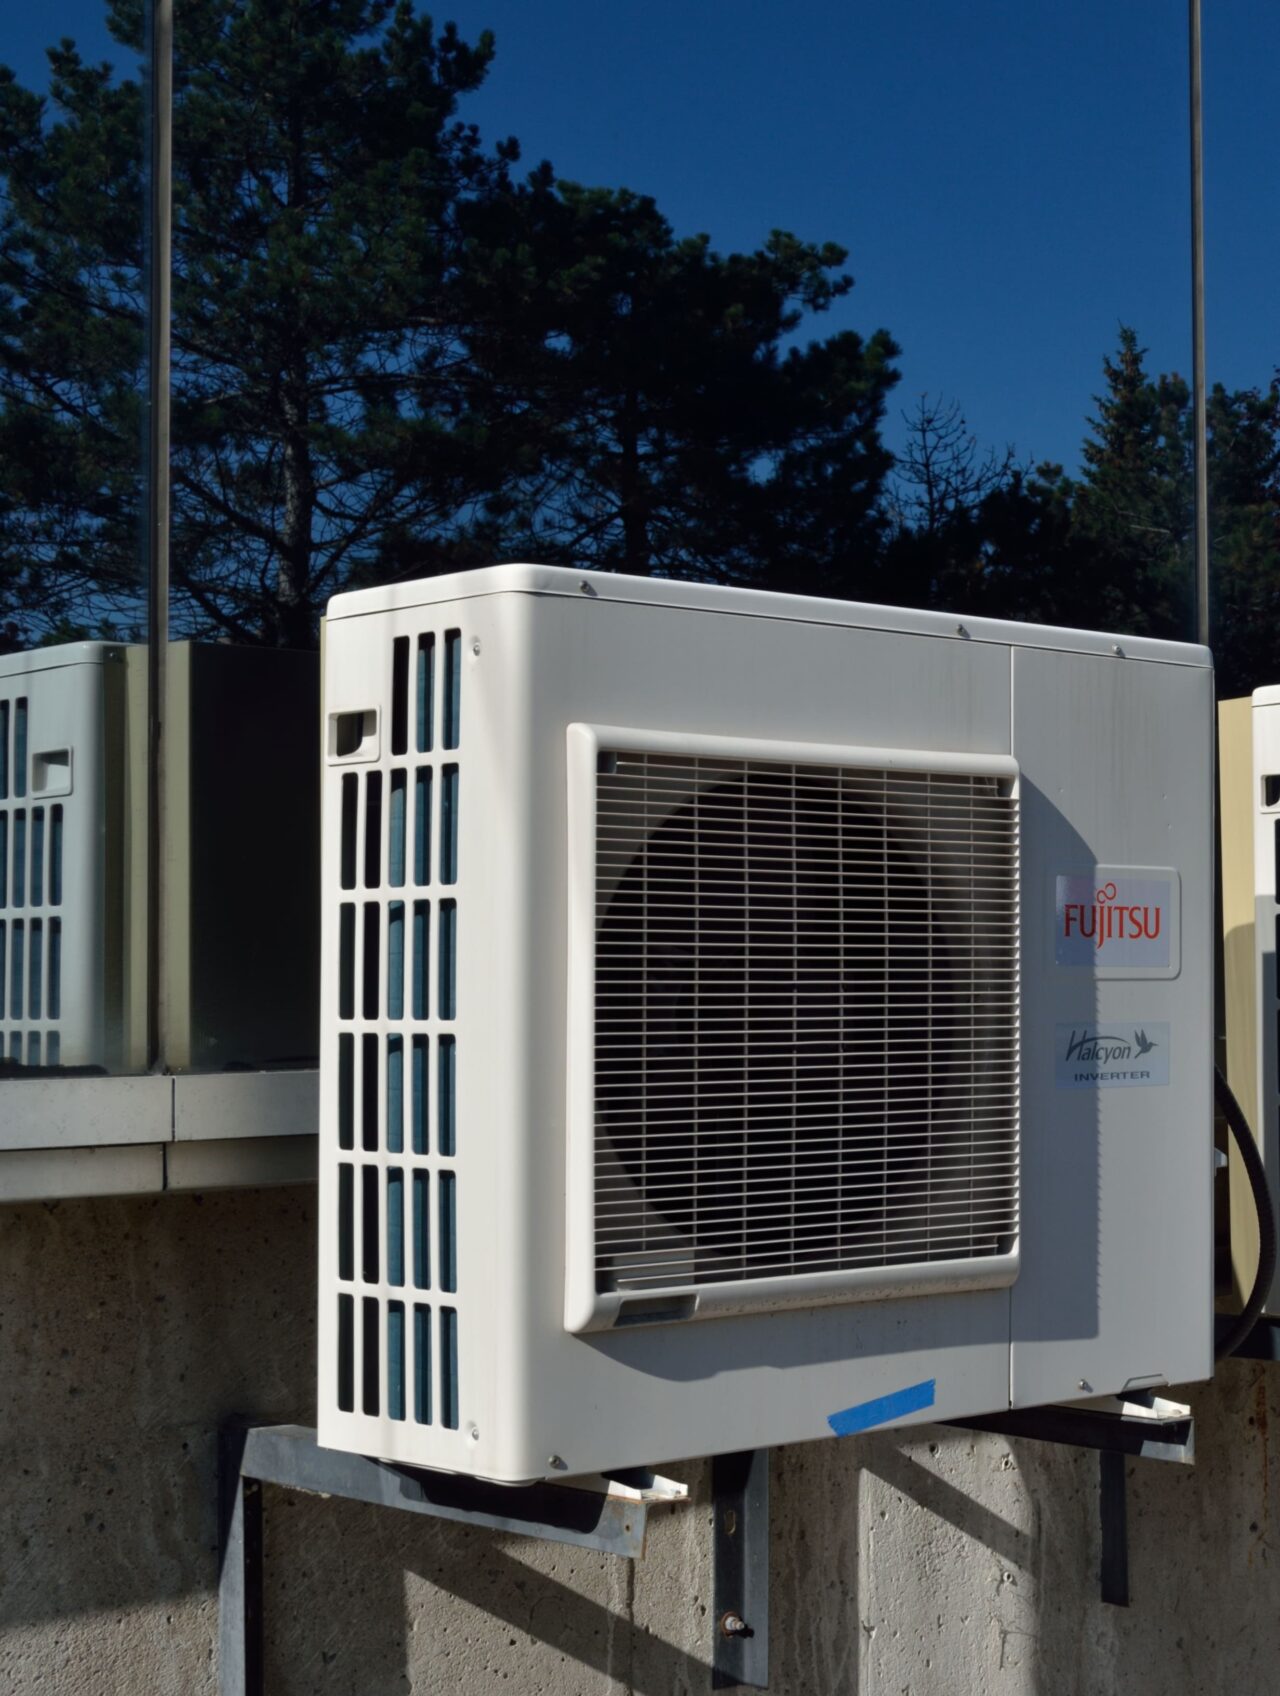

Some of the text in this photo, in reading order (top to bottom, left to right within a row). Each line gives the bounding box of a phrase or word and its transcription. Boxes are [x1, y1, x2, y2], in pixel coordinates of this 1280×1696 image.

[1064, 903, 1160, 949] FUJITSU
[1066, 1029, 1131, 1064] Halcyon
[1074, 1070, 1150, 1082] INVERTER
